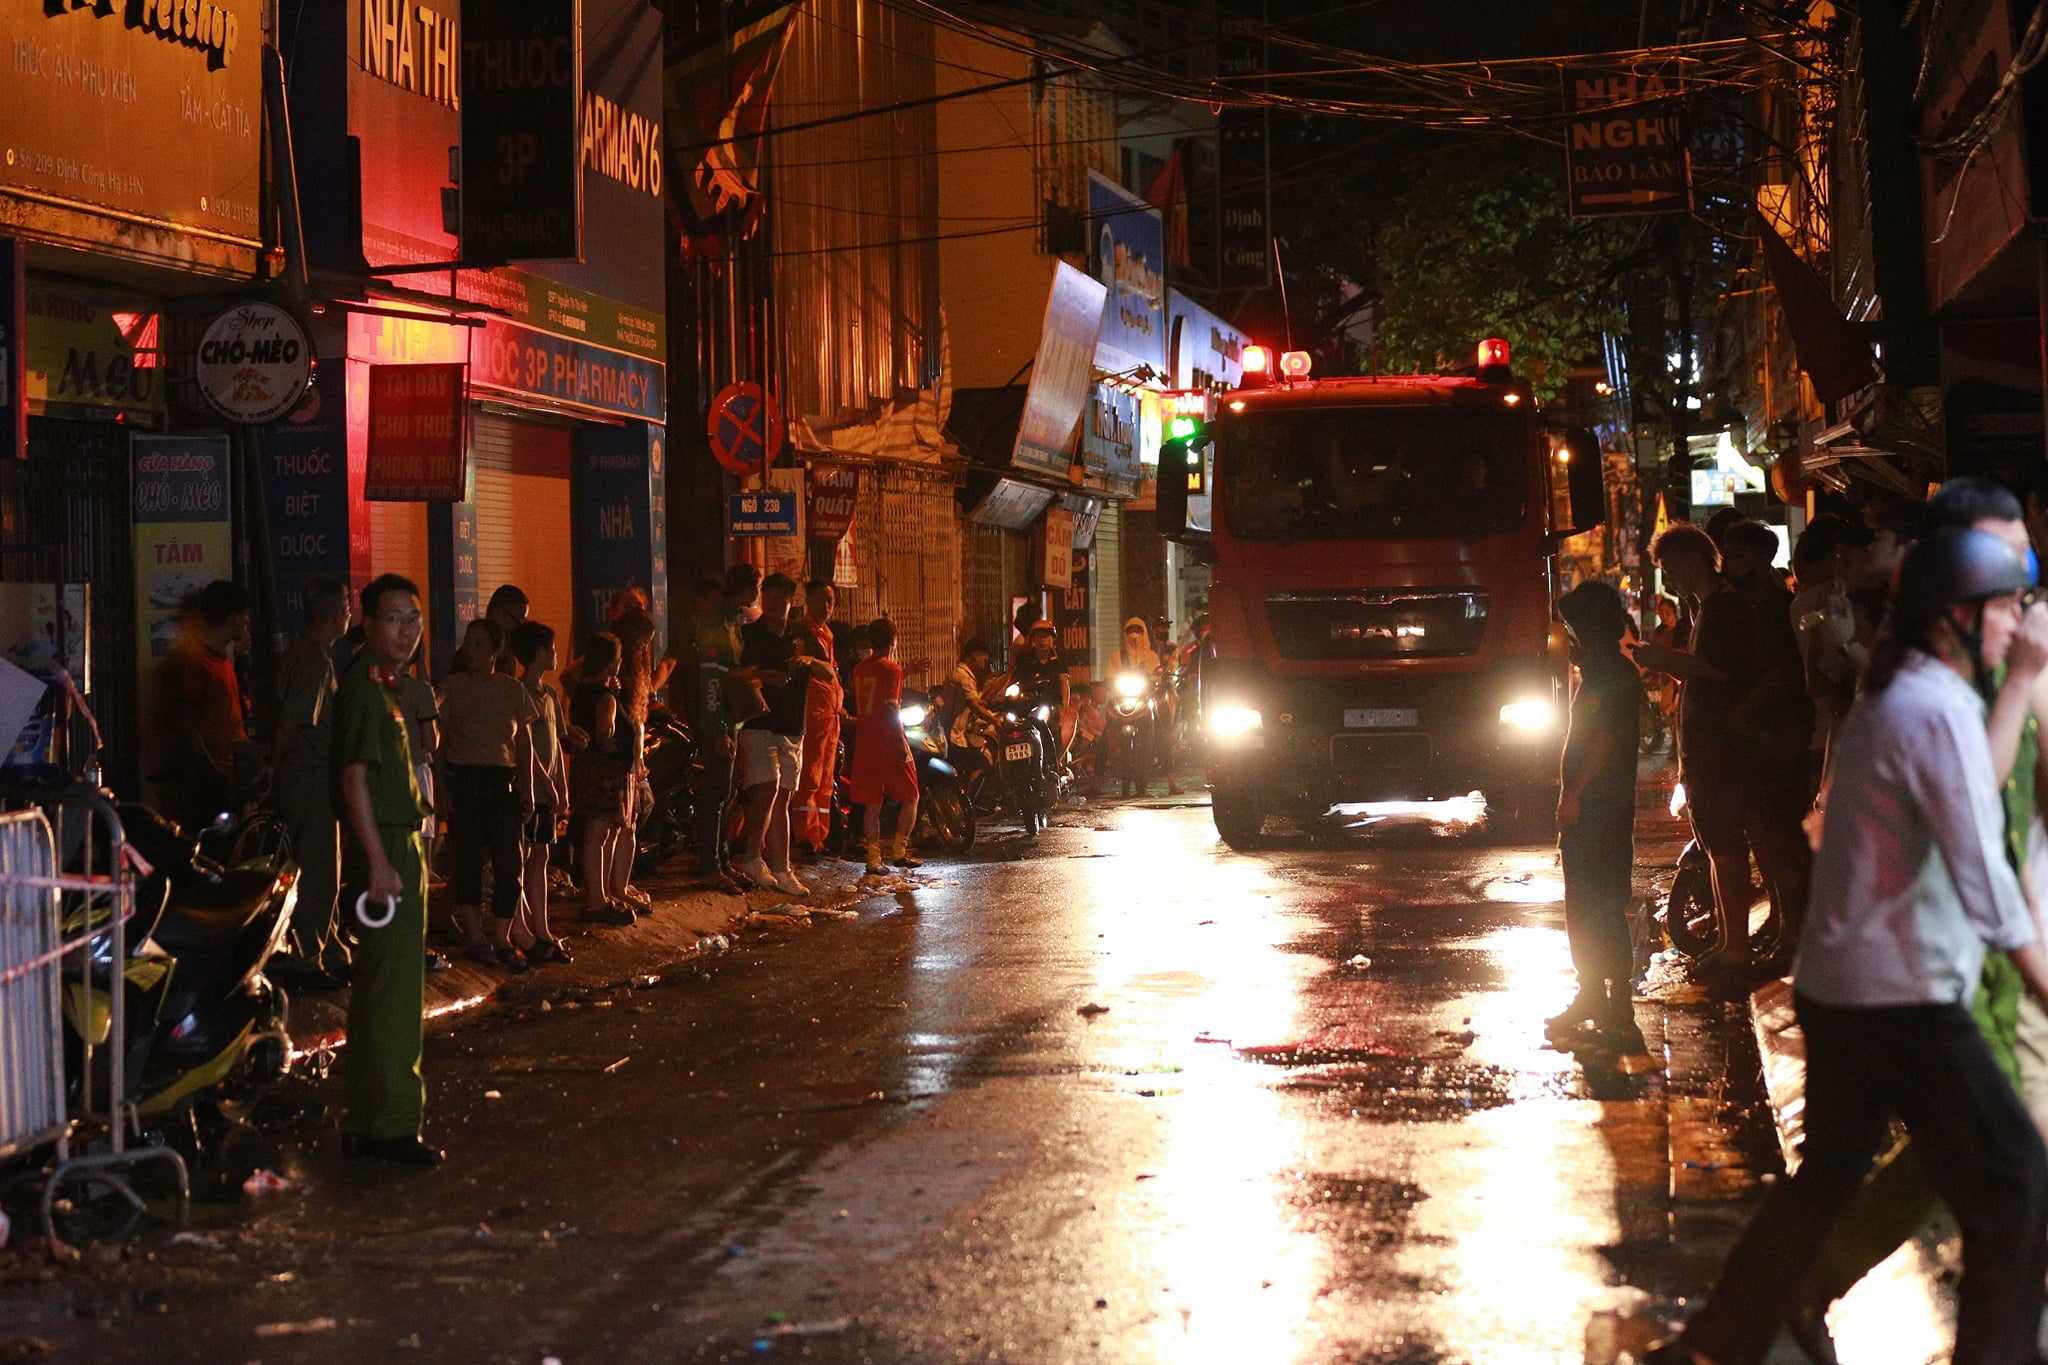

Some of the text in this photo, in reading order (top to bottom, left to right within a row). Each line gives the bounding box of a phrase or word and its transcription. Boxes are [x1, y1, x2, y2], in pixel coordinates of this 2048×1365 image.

[526, 347, 549, 388] 3P
[553, 353, 650, 408] PHARMACY
[274, 447, 332, 475] THUỐC
[764, 499, 781, 513] 230
[154, 536, 204, 565] TẮM
